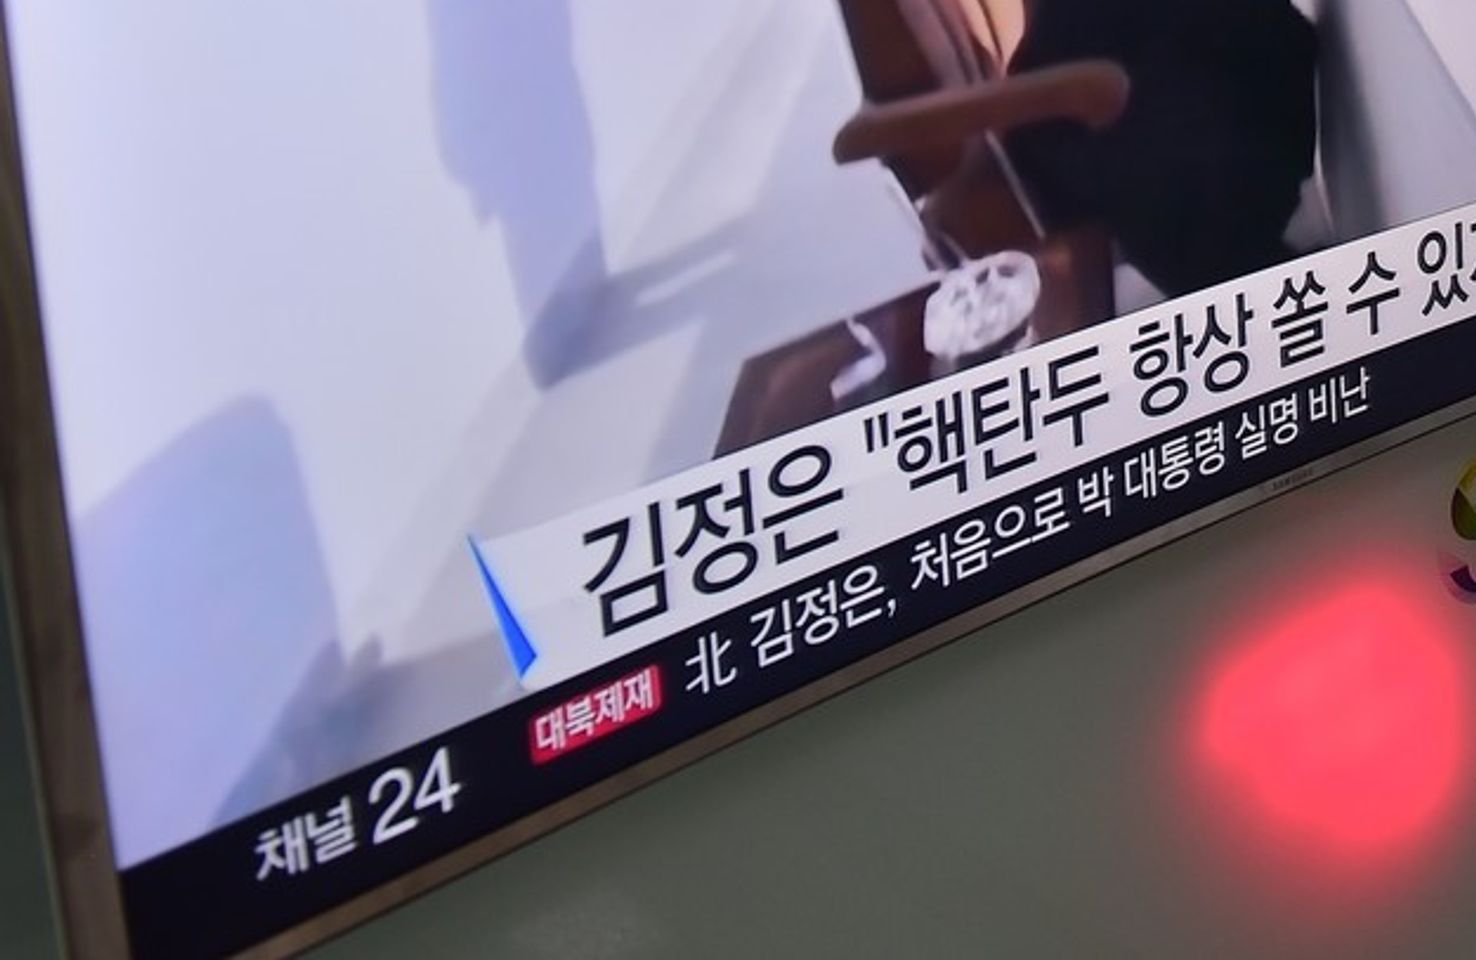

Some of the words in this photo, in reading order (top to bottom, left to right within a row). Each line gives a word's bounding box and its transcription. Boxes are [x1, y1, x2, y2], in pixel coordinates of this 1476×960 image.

[582, 444, 844, 638] 김정은
[863, 345, 1109, 495] "핵탄두
[1129, 292, 1255, 418] 항상
[1270, 270, 1329, 369] 쏠
[1345, 251, 1401, 336] 수
[684, 632, 737, 695] 北
[749, 563, 898, 668] 김정은,
[909, 486, 1071, 592] 처음으로
[1078, 466, 1114, 519] 박
[1123, 420, 1226, 500] 대통령
[1235, 391, 1300, 457] 실명
[1308, 366, 1371, 426] 비난
[254, 795, 357, 884] 채널
[367, 745, 466, 844] 24
[532, 667, 656, 754] 대북제재
